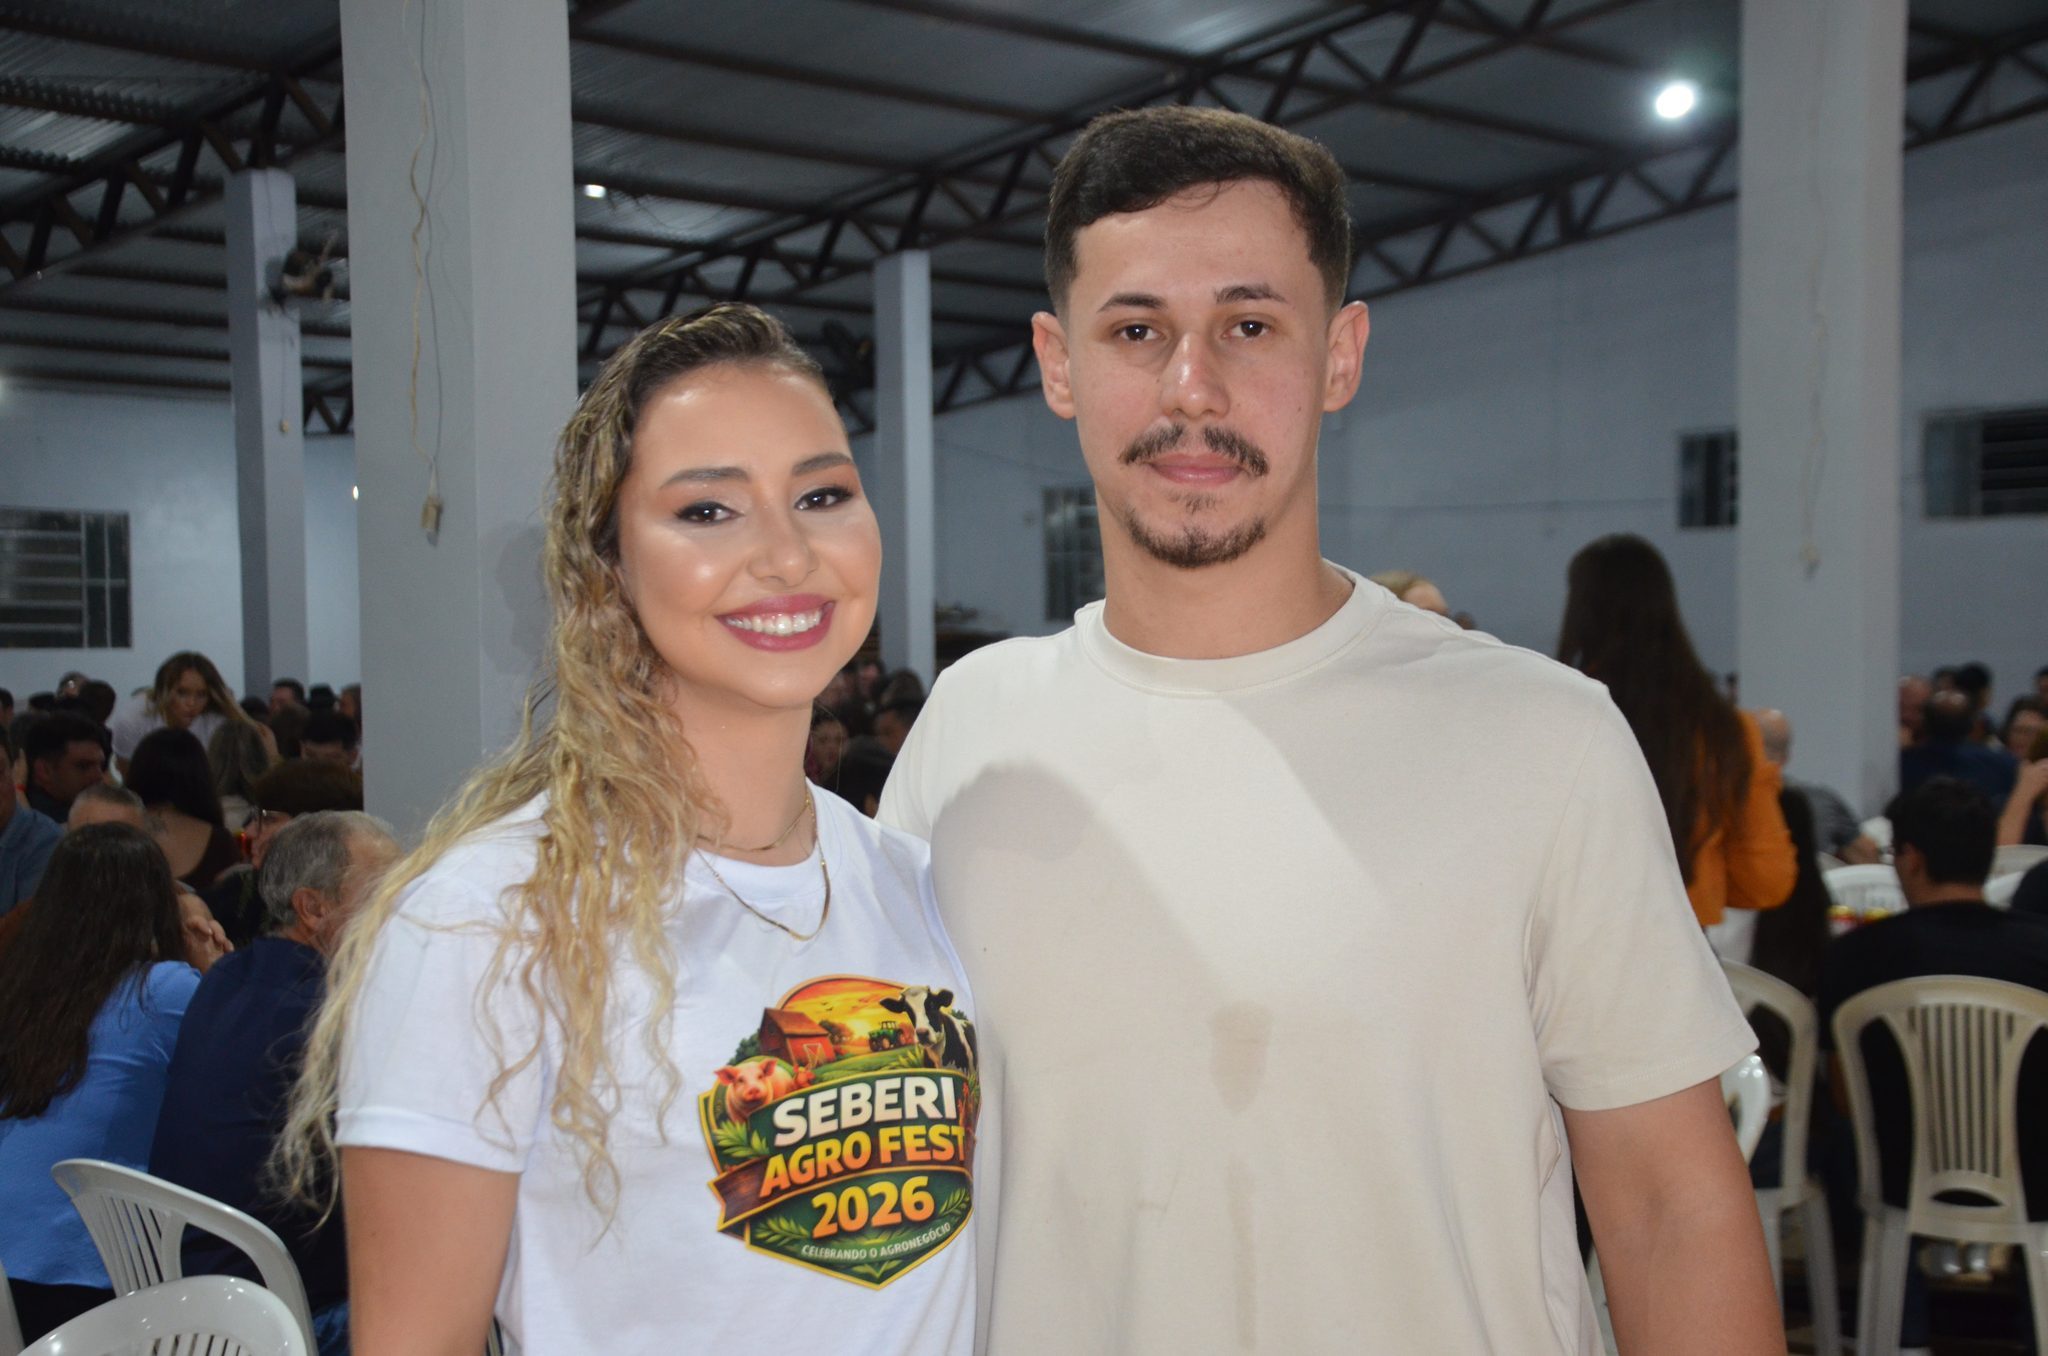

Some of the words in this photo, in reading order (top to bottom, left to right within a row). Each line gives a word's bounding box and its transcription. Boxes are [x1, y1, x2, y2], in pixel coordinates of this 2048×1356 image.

[773, 1076, 957, 1147] SEBERI
[759, 1131, 871, 1198] AGRO
[878, 1124, 965, 1164] FEST
[802, 1244, 867, 1260] CELEBRANDO
[869, 1248, 878, 1259] O
[880, 1222, 951, 1257] AGRONEGÓCIO
[812, 1176, 935, 1239] 2026
